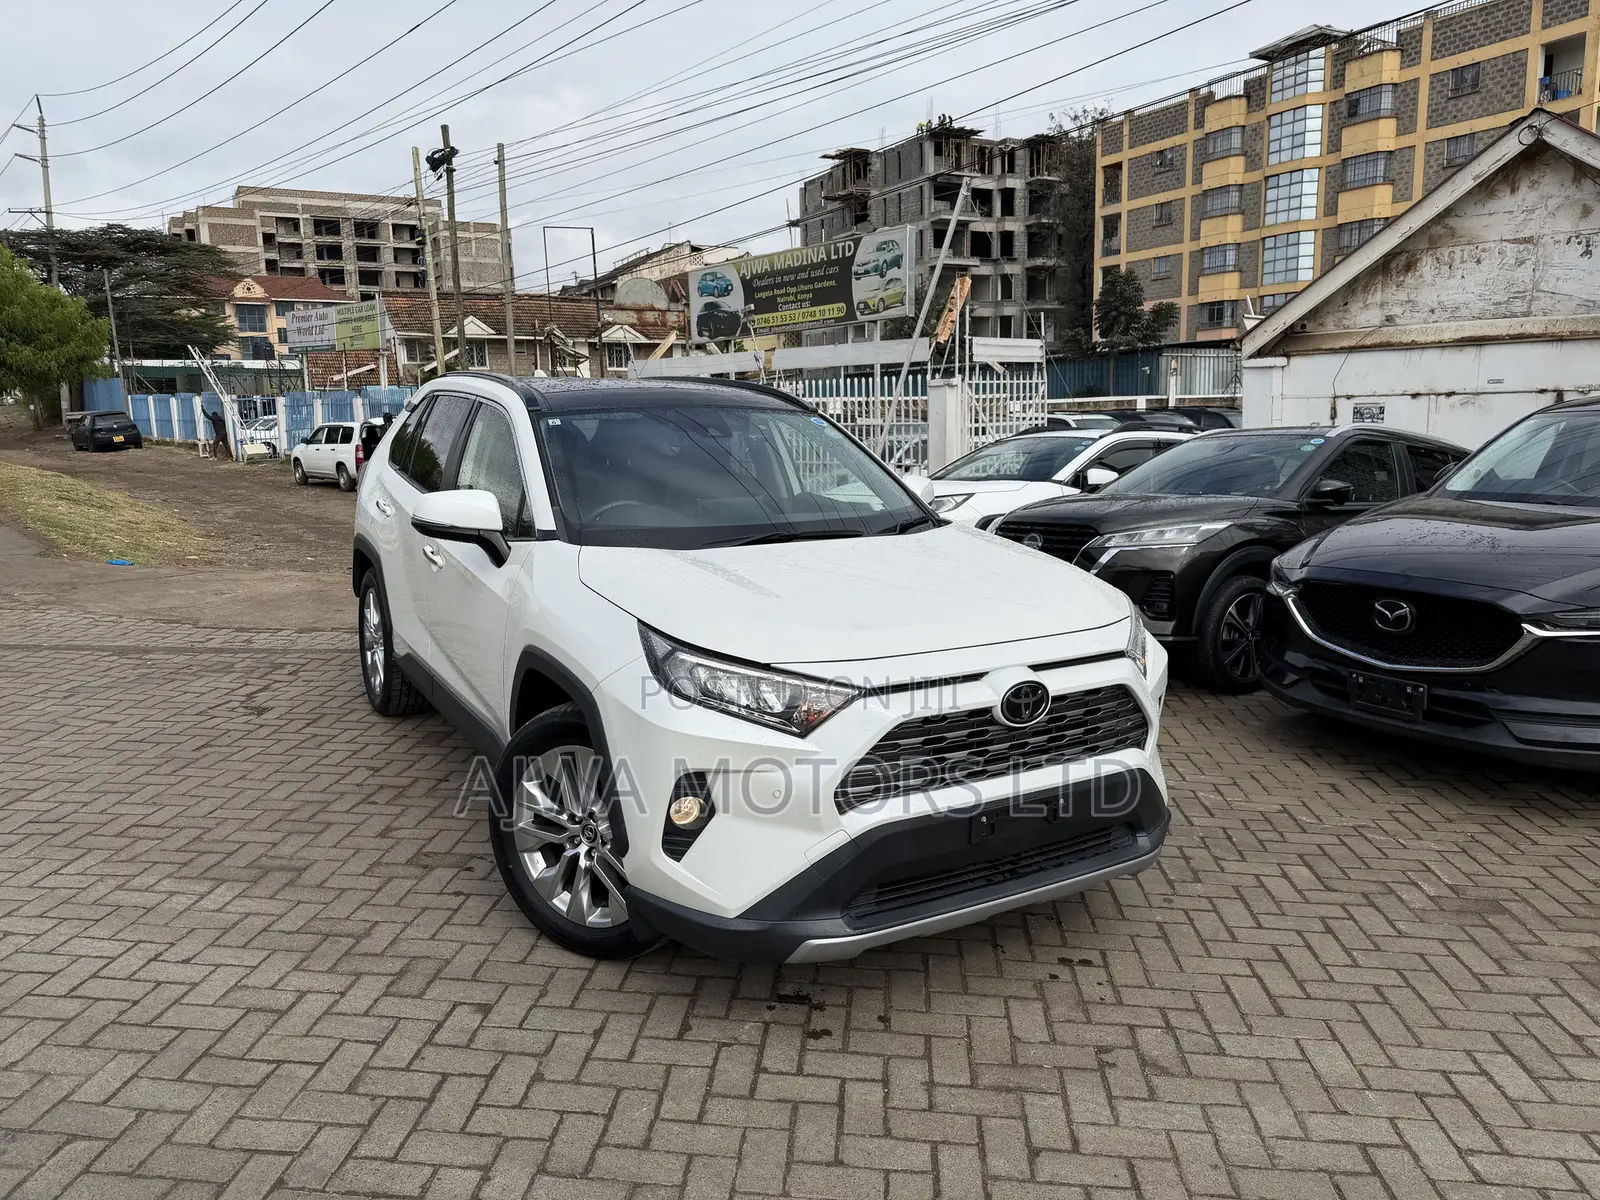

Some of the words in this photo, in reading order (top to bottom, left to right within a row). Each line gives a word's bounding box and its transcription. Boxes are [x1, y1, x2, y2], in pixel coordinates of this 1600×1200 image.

[740, 259, 771, 280] AJWA
[774, 246, 827, 270] MADINA
[830, 241, 854, 260] LTD
[752, 275, 775, 288] Dealers
[775, 274, 782, 282] in
[782, 272, 797, 282] new
[796, 267, 810, 280] and
[810, 264, 826, 278] used
[825, 265, 840, 275] cars
[754, 291, 773, 299] Langata
[773, 287, 786, 296] Road
[797, 292, 813, 301] Kenya
[355, 303, 364, 314] CAR
[364, 302, 376, 312] LOAN
[778, 301, 801, 312] Contact
[801, 300, 812, 308] us:
[291, 311, 314, 325] Premier
[314, 310, 329, 322] Auto
[756, 316, 771, 326] 0746
[771, 315, 779, 324] 51
[780, 314, 788, 323] 53
[788, 312, 797, 321] 53
[801, 310, 817, 320] 0748
[818, 308, 826, 317] 10
[828, 307, 835, 316] 11
[836, 305, 845, 315] 90
[296, 324, 314, 337] World
[314, 323, 326, 336] Ltd
